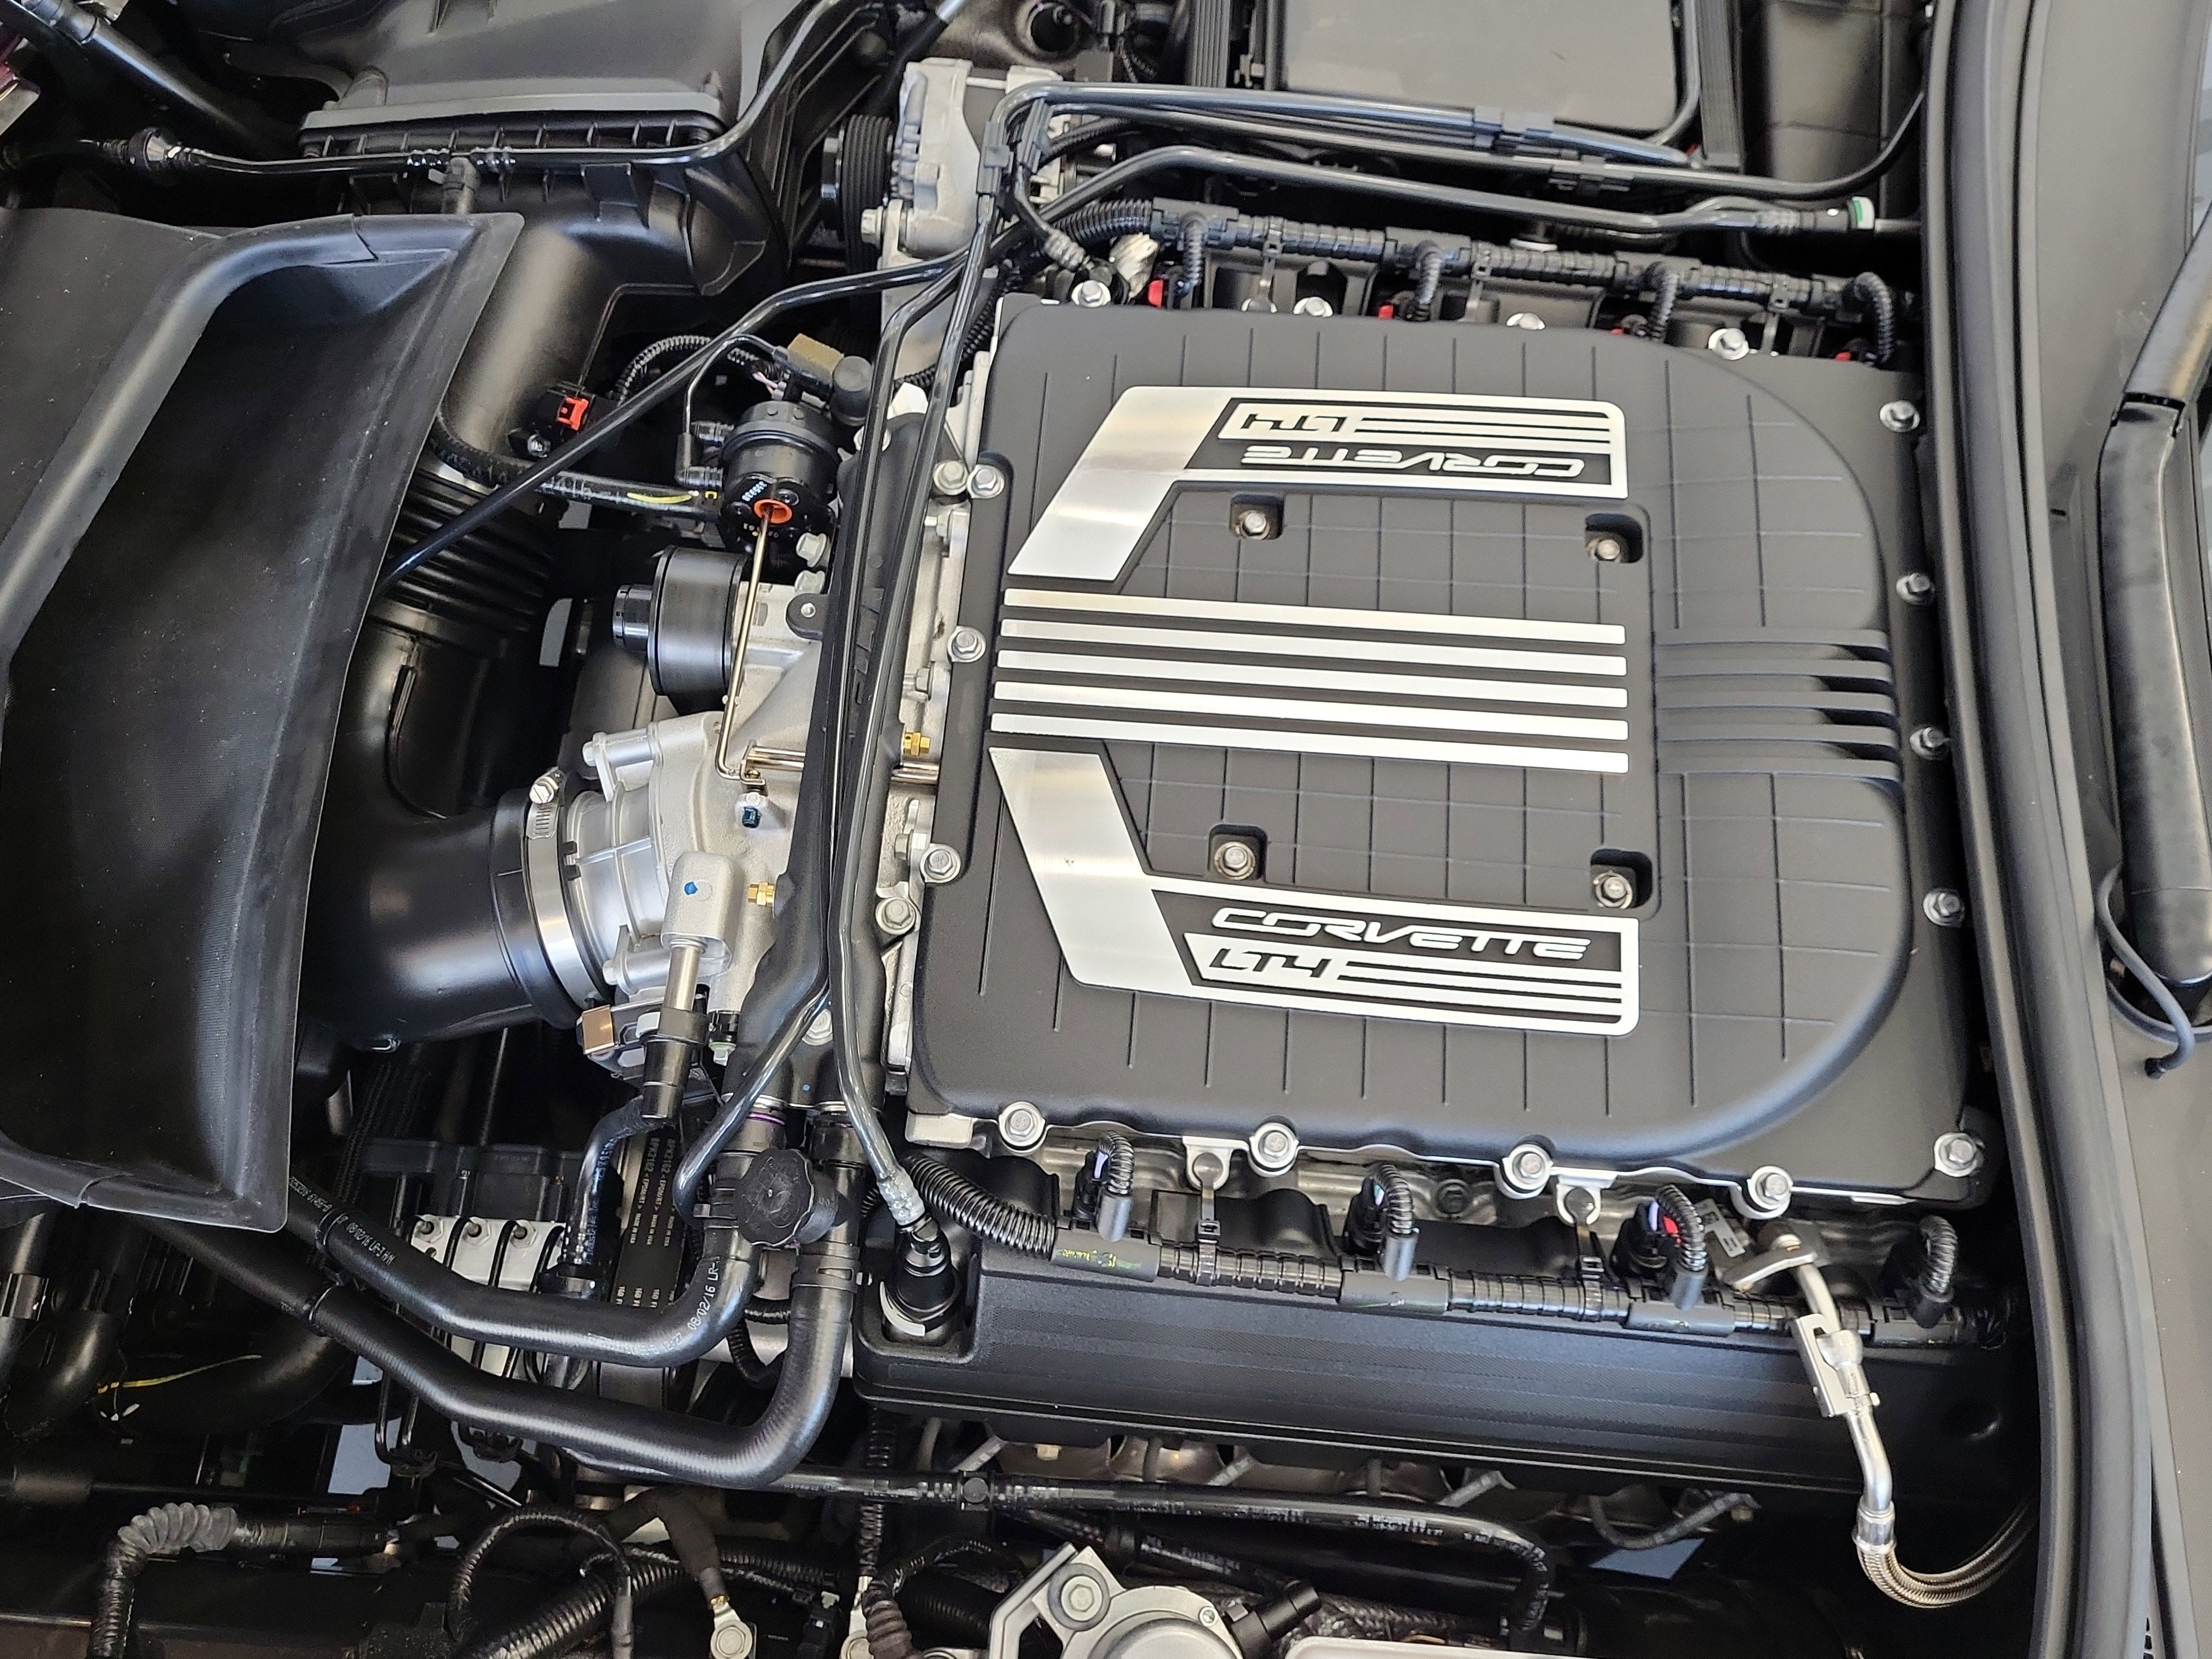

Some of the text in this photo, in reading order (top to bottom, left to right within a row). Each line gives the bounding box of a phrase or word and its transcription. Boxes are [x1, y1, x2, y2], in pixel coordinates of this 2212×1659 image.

[1240, 413, 1348, 434] LT4
[1240, 445, 1586, 478] CORVETTE
[1212, 907, 1592, 961] CORVETTE
[1209, 947, 1337, 979] LT4
[687, 1285, 716, 1331] 08/02/16
